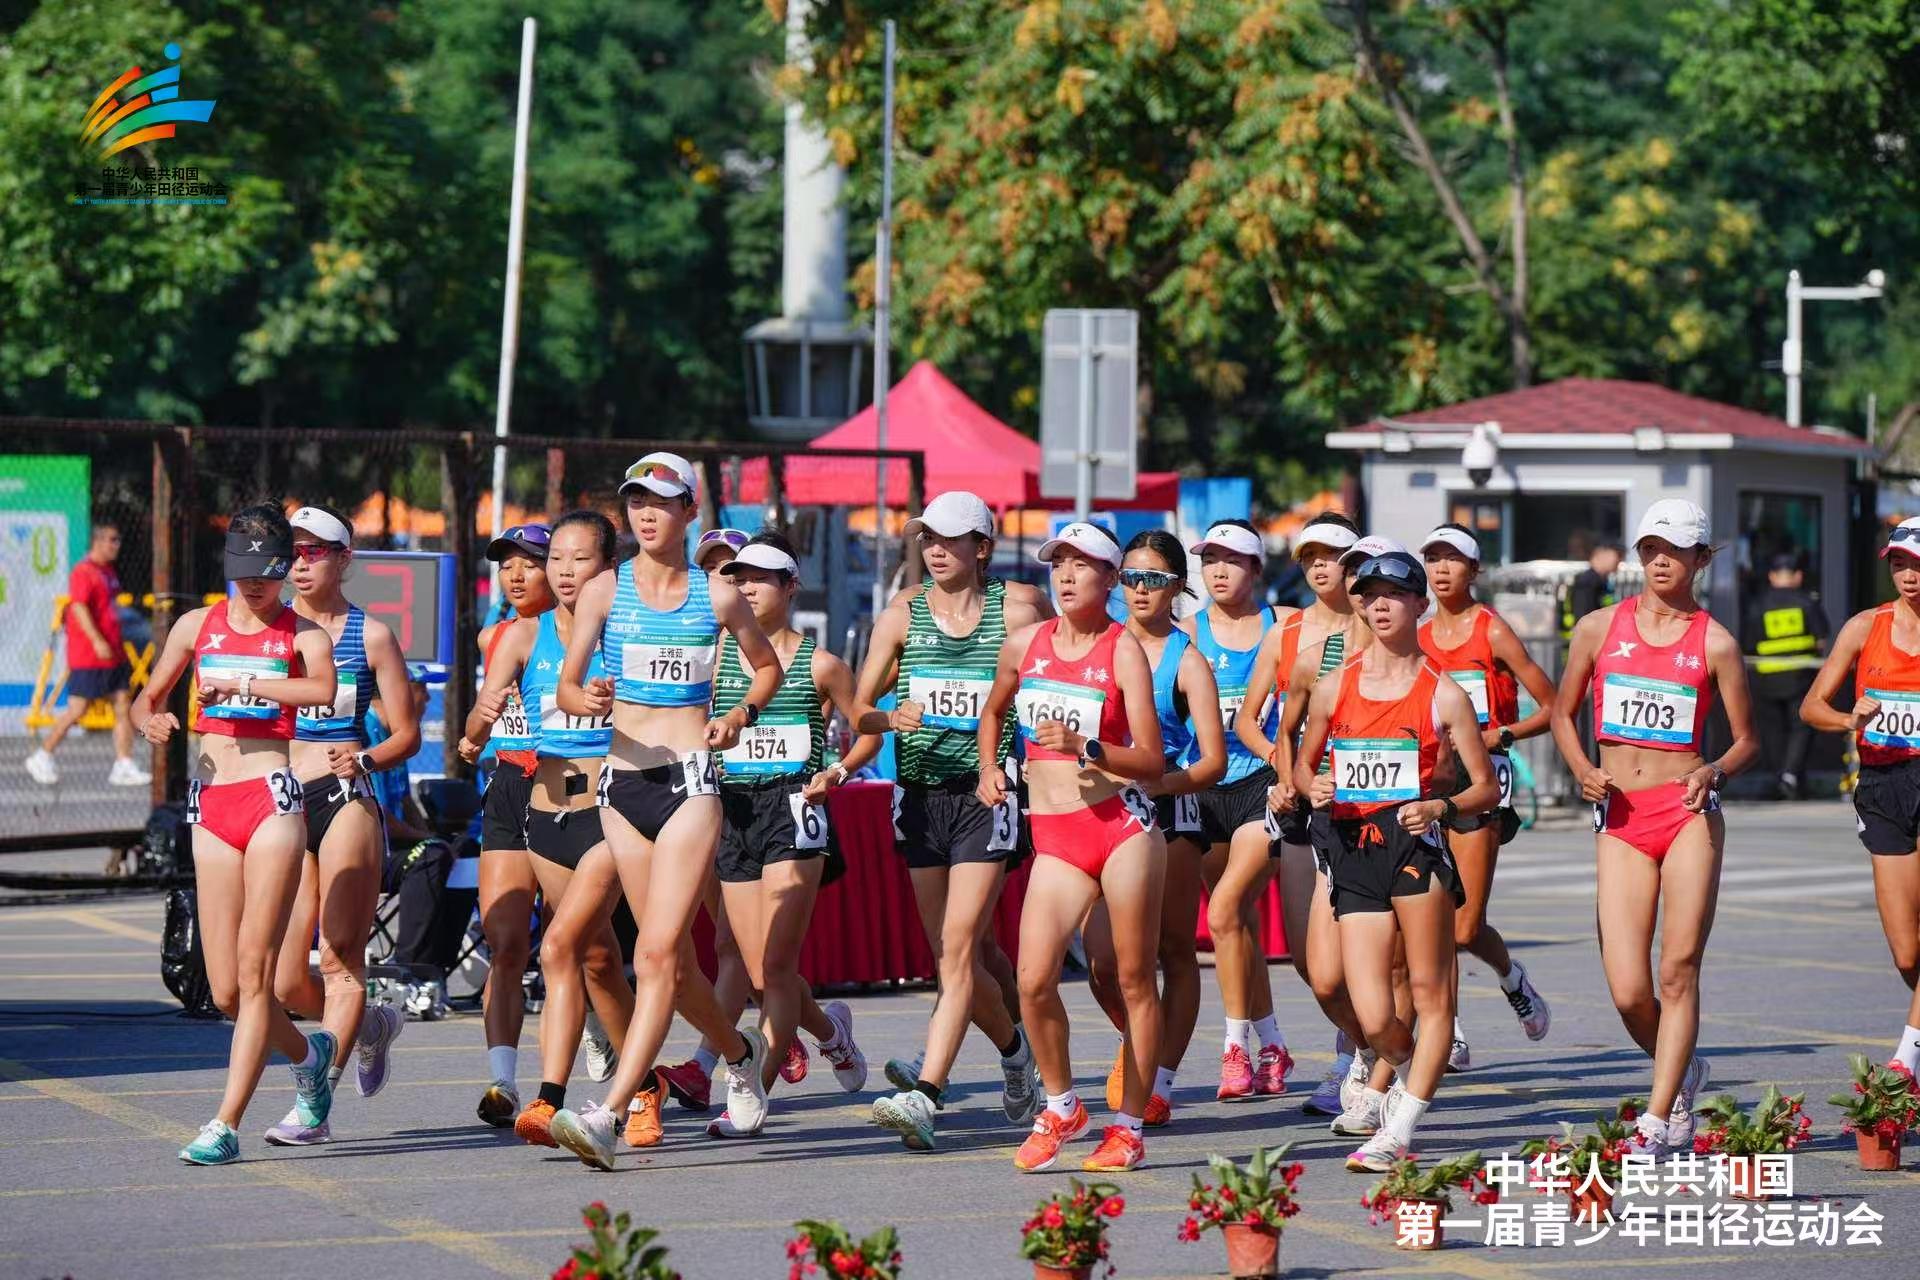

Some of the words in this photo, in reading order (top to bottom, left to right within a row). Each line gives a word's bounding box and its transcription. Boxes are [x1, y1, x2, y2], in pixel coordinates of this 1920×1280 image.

[261, 641, 288, 655] 青海
[1672, 652, 1700, 669] 青海
[649, 660, 690, 681] 1761
[1081, 666, 1110, 682] 青海
[929, 690, 979, 717] 1551
[1620, 699, 1675, 730] 1703
[1028, 701, 1081, 735] 1696
[746, 739, 787, 759] 1574
[1346, 763, 1402, 789] 2007
[271, 772, 304, 812] 34
[801, 801, 820, 840] 6
